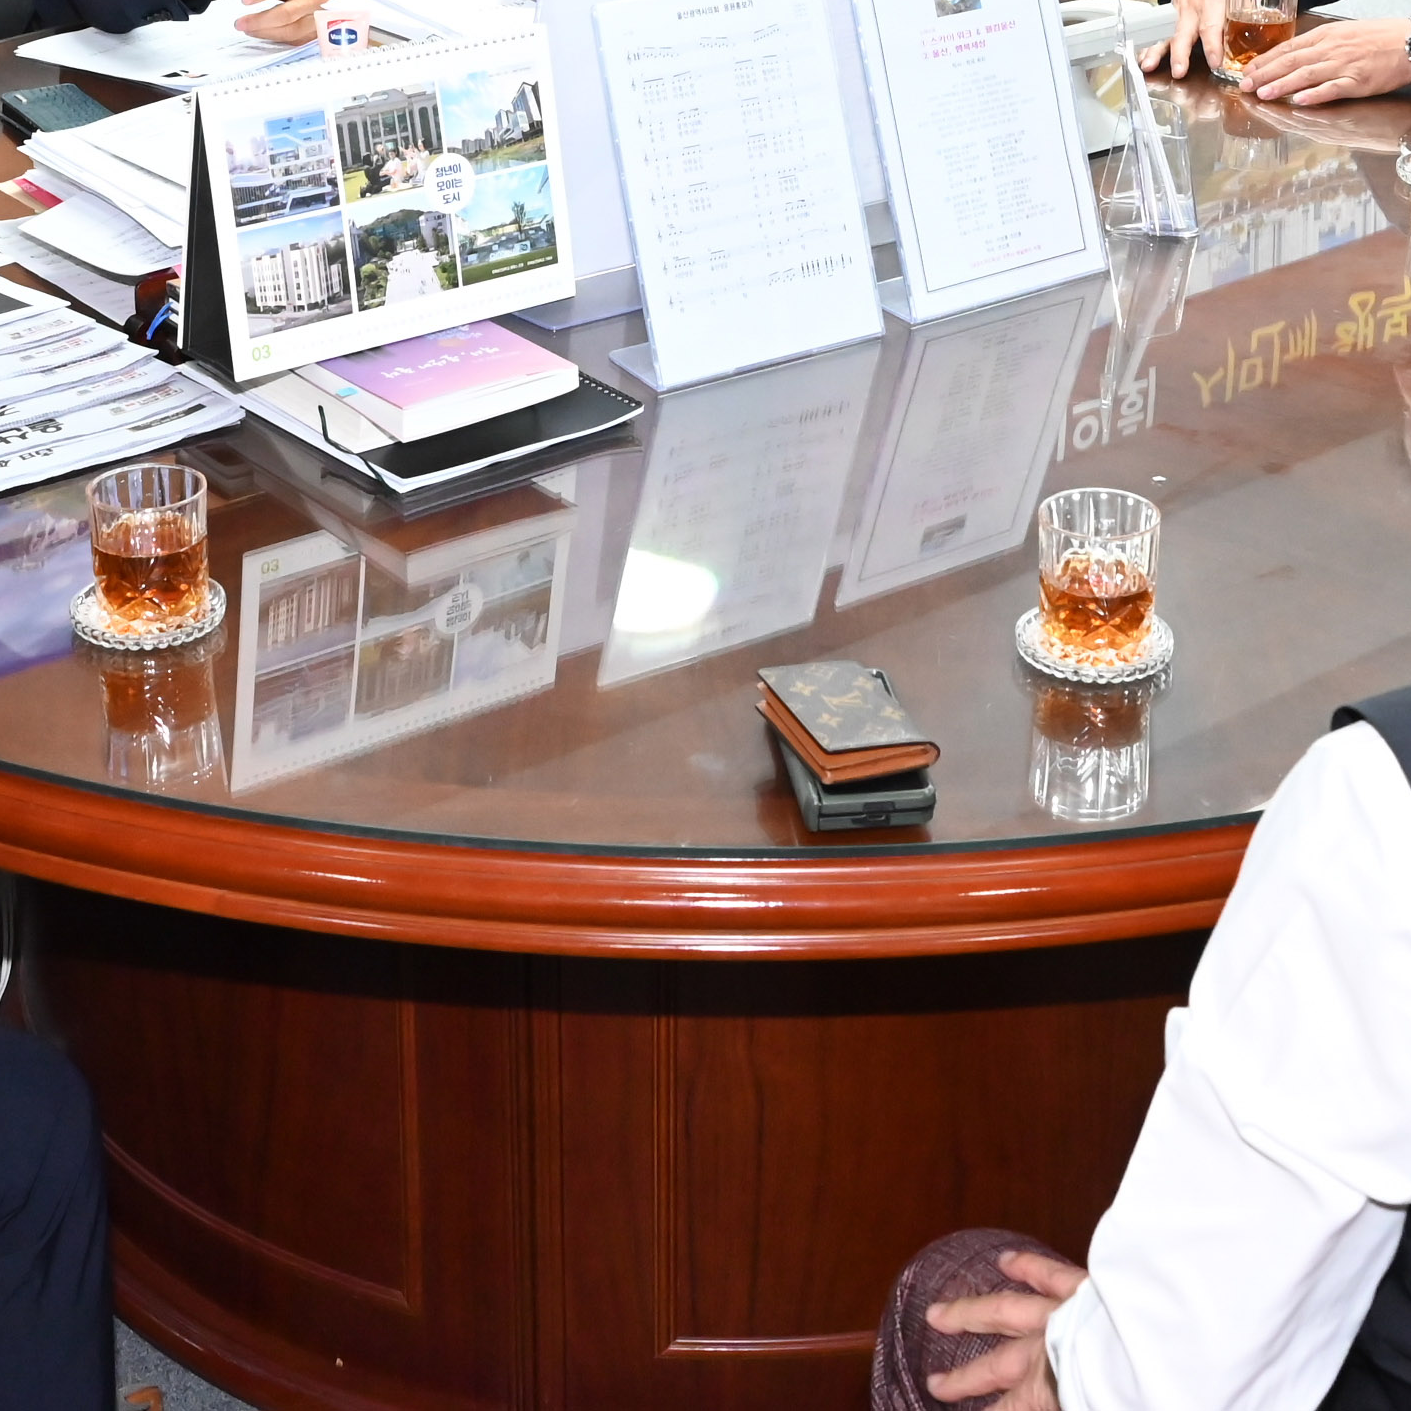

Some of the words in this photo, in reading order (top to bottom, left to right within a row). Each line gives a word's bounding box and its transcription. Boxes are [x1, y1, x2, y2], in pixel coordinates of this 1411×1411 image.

[676, 5, 720, 20] 울산광역시의회
[435, 163, 462, 177] 청년이
[436, 178, 463, 192] 모이는
[442, 191, 461, 205] 도시
[251, 344, 271, 362] 03
